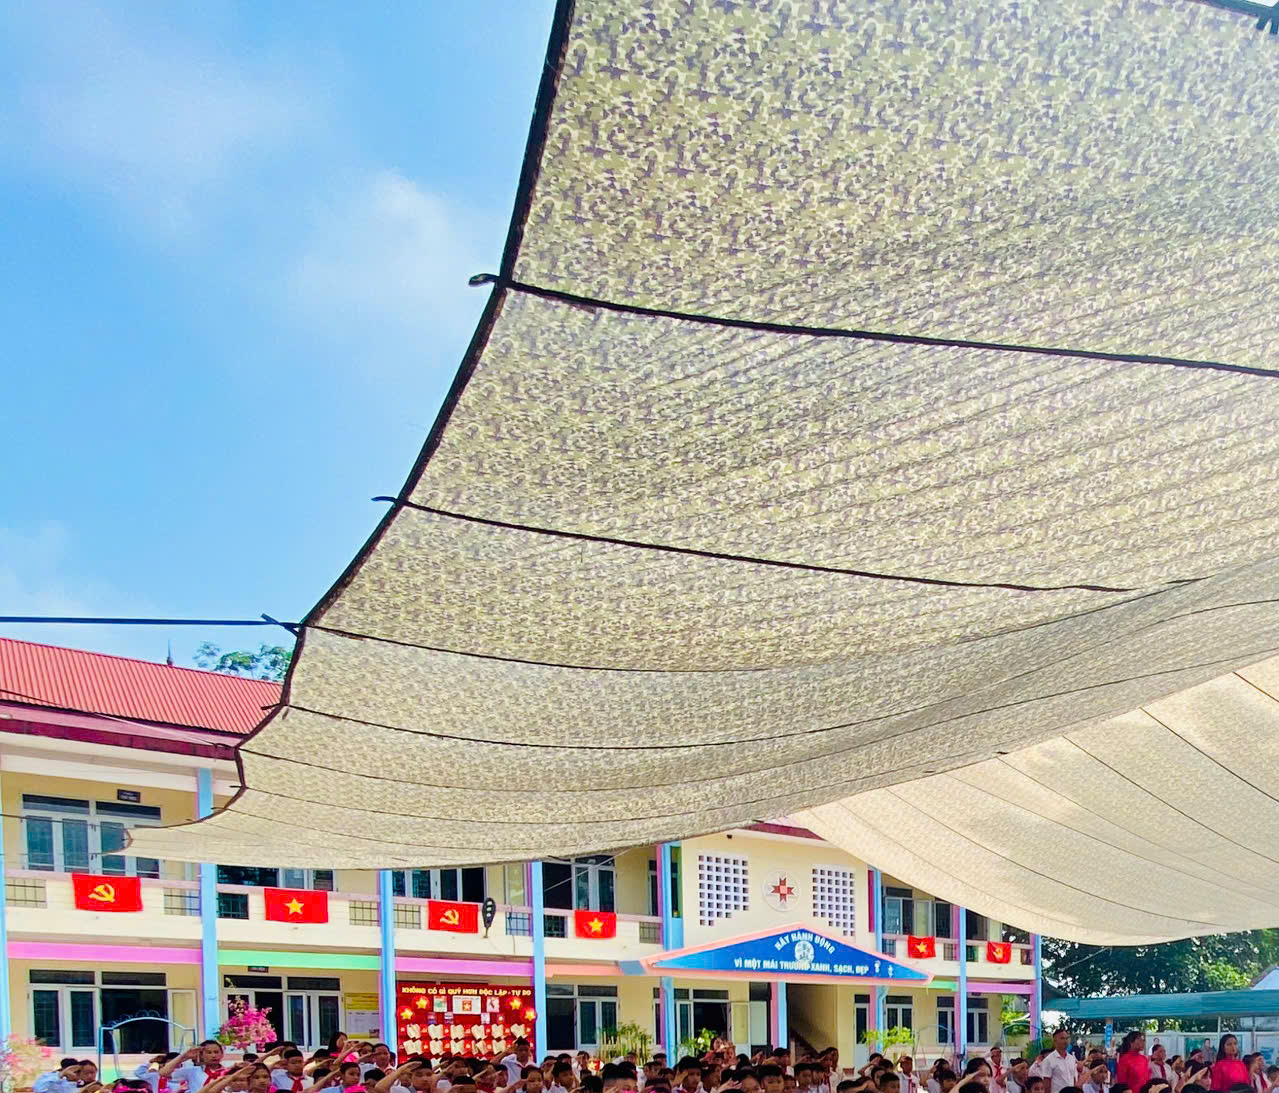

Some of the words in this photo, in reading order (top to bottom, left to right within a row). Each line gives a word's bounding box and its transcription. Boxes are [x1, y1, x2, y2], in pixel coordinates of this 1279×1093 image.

[734, 957, 743, 968] VÌ
[744, 957, 761, 970] MỘT
[763, 958, 779, 969] MÁI
[855, 965, 869, 975] ĐẸP
[402, 986, 426, 994] KHÔNG
[427, 987, 438, 995] CÓ
[439, 986, 447, 995] GÌ
[447, 987, 462, 995] QUÝ
[479, 988, 494, 996] ĐỘC
[511, 989, 522, 997] TỰ
